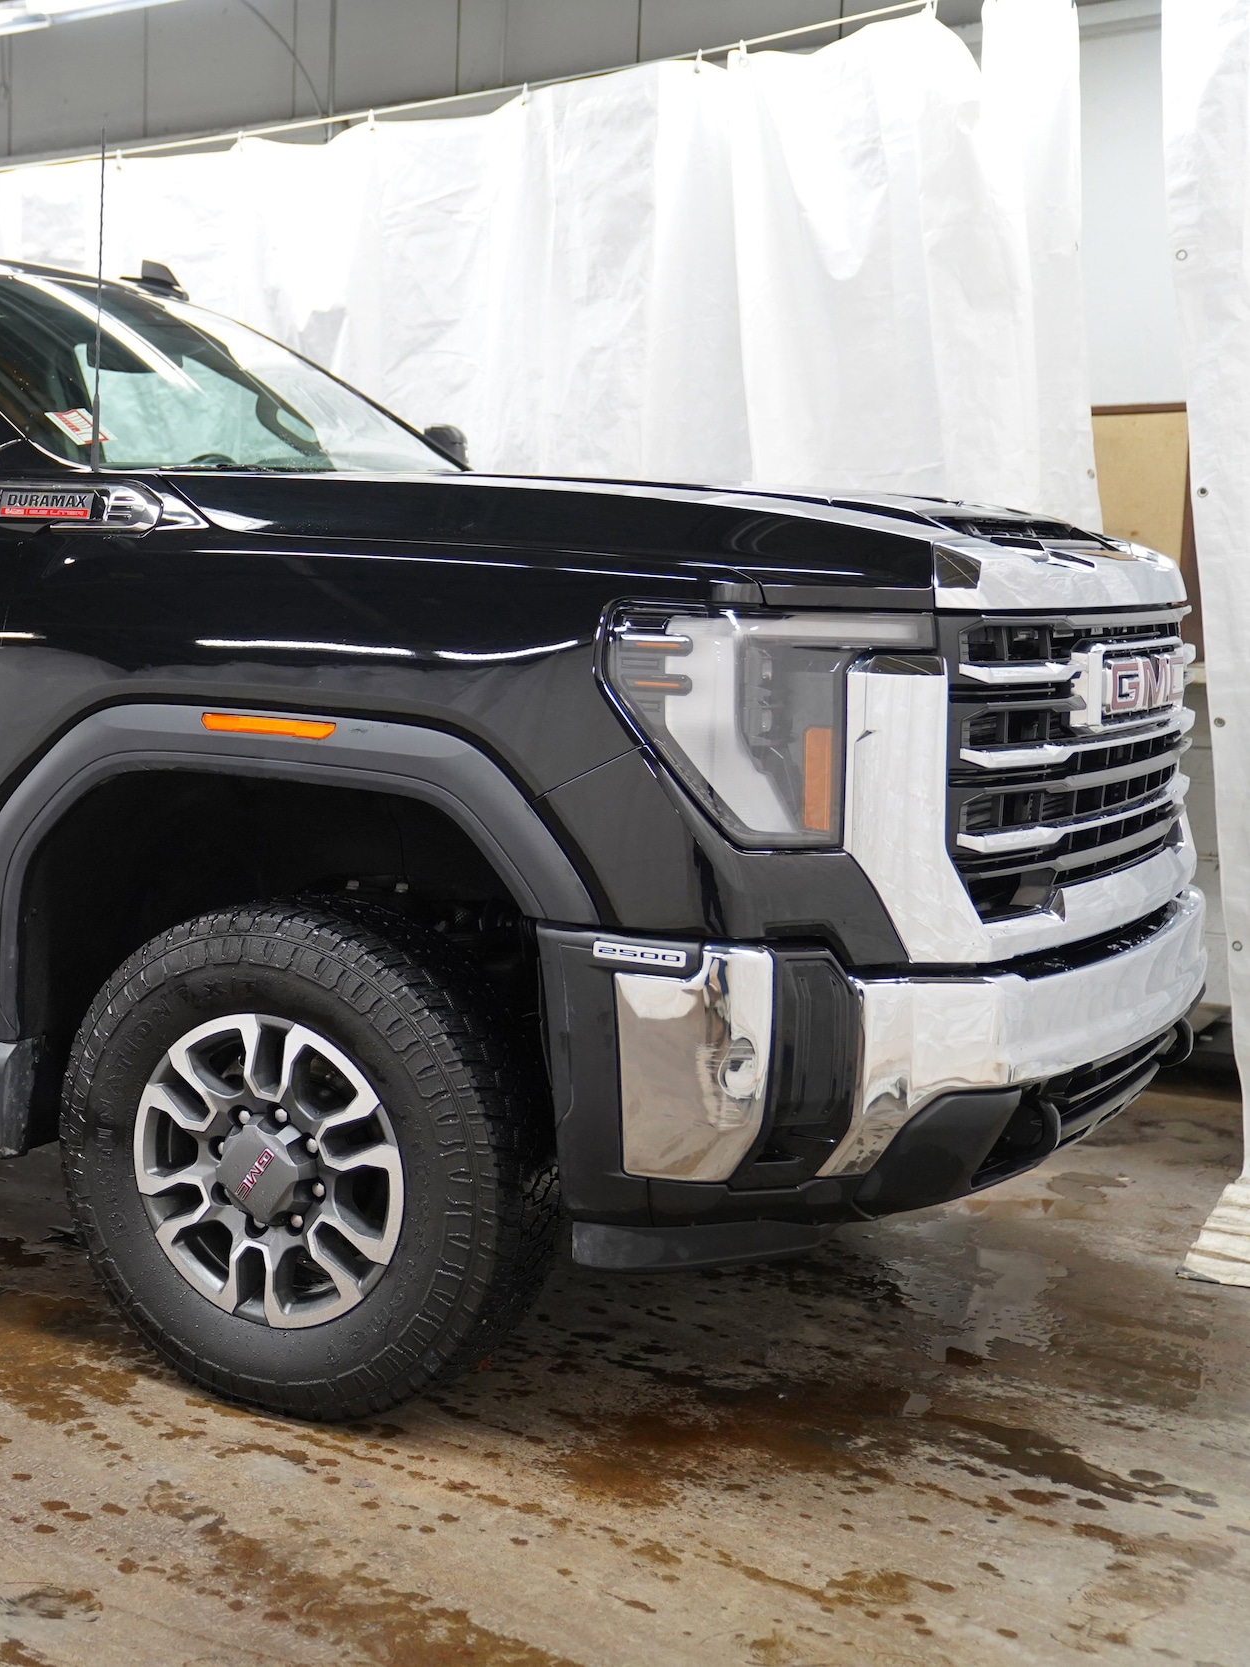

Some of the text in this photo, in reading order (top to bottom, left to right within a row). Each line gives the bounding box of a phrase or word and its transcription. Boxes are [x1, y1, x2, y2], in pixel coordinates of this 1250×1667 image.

[7, 494, 87, 508] DURAMAX
[1106, 654, 1184, 714] GMC
[598, 946, 681, 962] 2500
[234, 1148, 275, 1201] GMC
